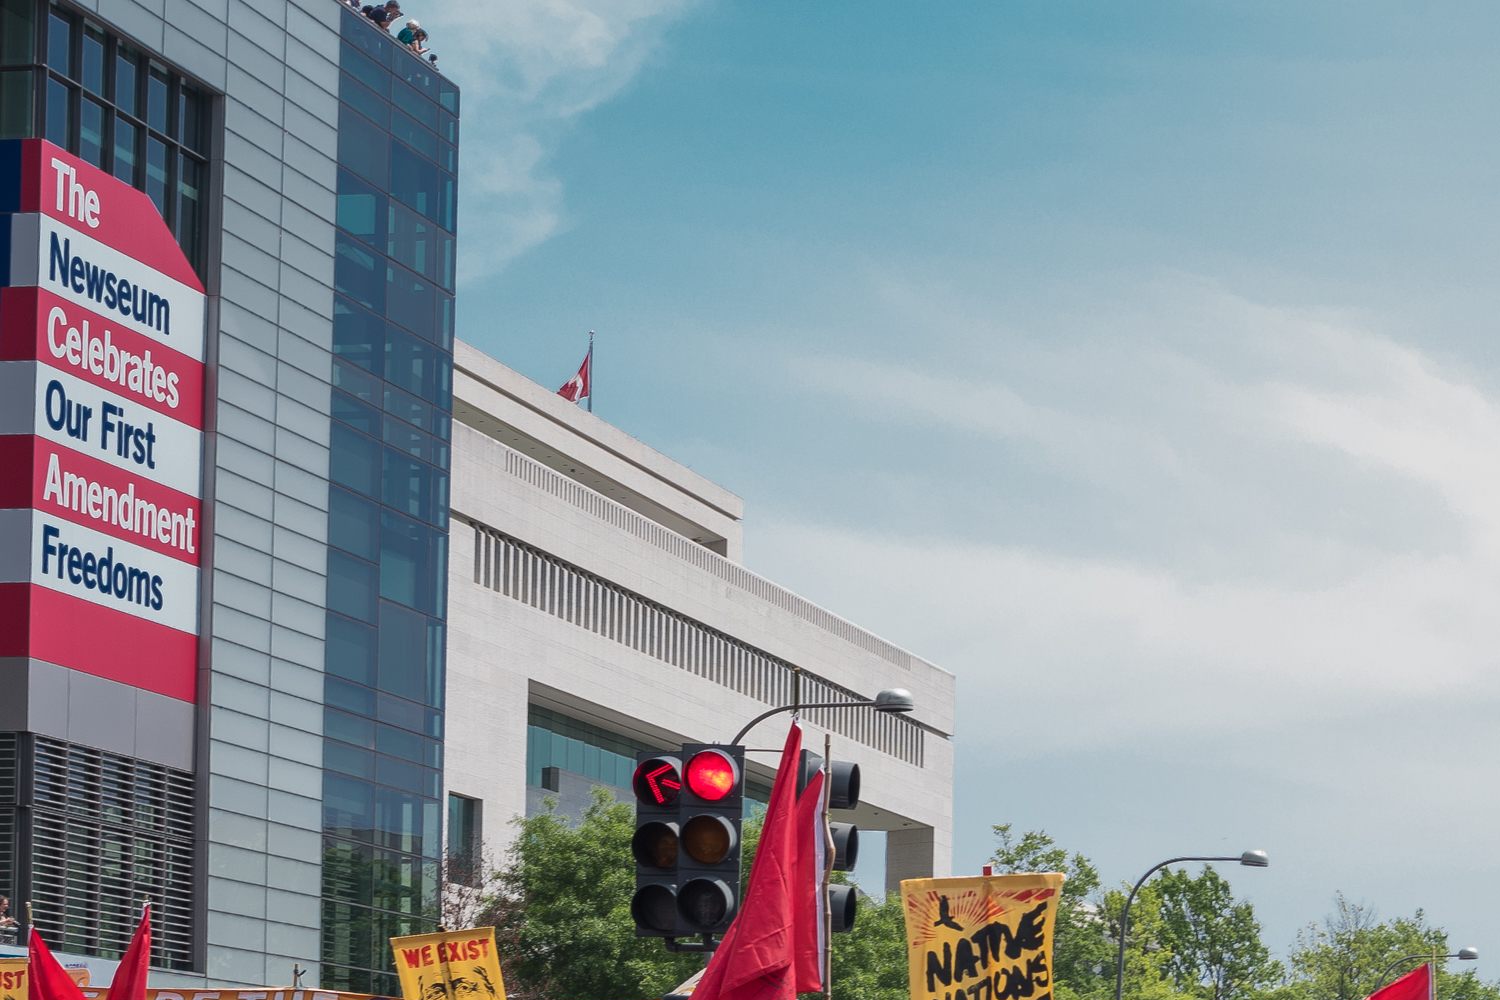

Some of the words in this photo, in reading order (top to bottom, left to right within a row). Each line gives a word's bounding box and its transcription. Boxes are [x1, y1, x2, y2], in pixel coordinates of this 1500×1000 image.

[51, 157, 101, 229] The
[49, 230, 170, 336] Newseum
[48, 306, 180, 409] Celebrates
[45, 379, 92, 442] Our
[101, 405, 156, 470] First
[43, 453, 195, 555] Amendment
[42, 524, 164, 611] Freedoms
[402, 945, 434, 968] WE
[437, 938, 489, 964] EXIST
[926, 901, 1047, 993] NATIVE
